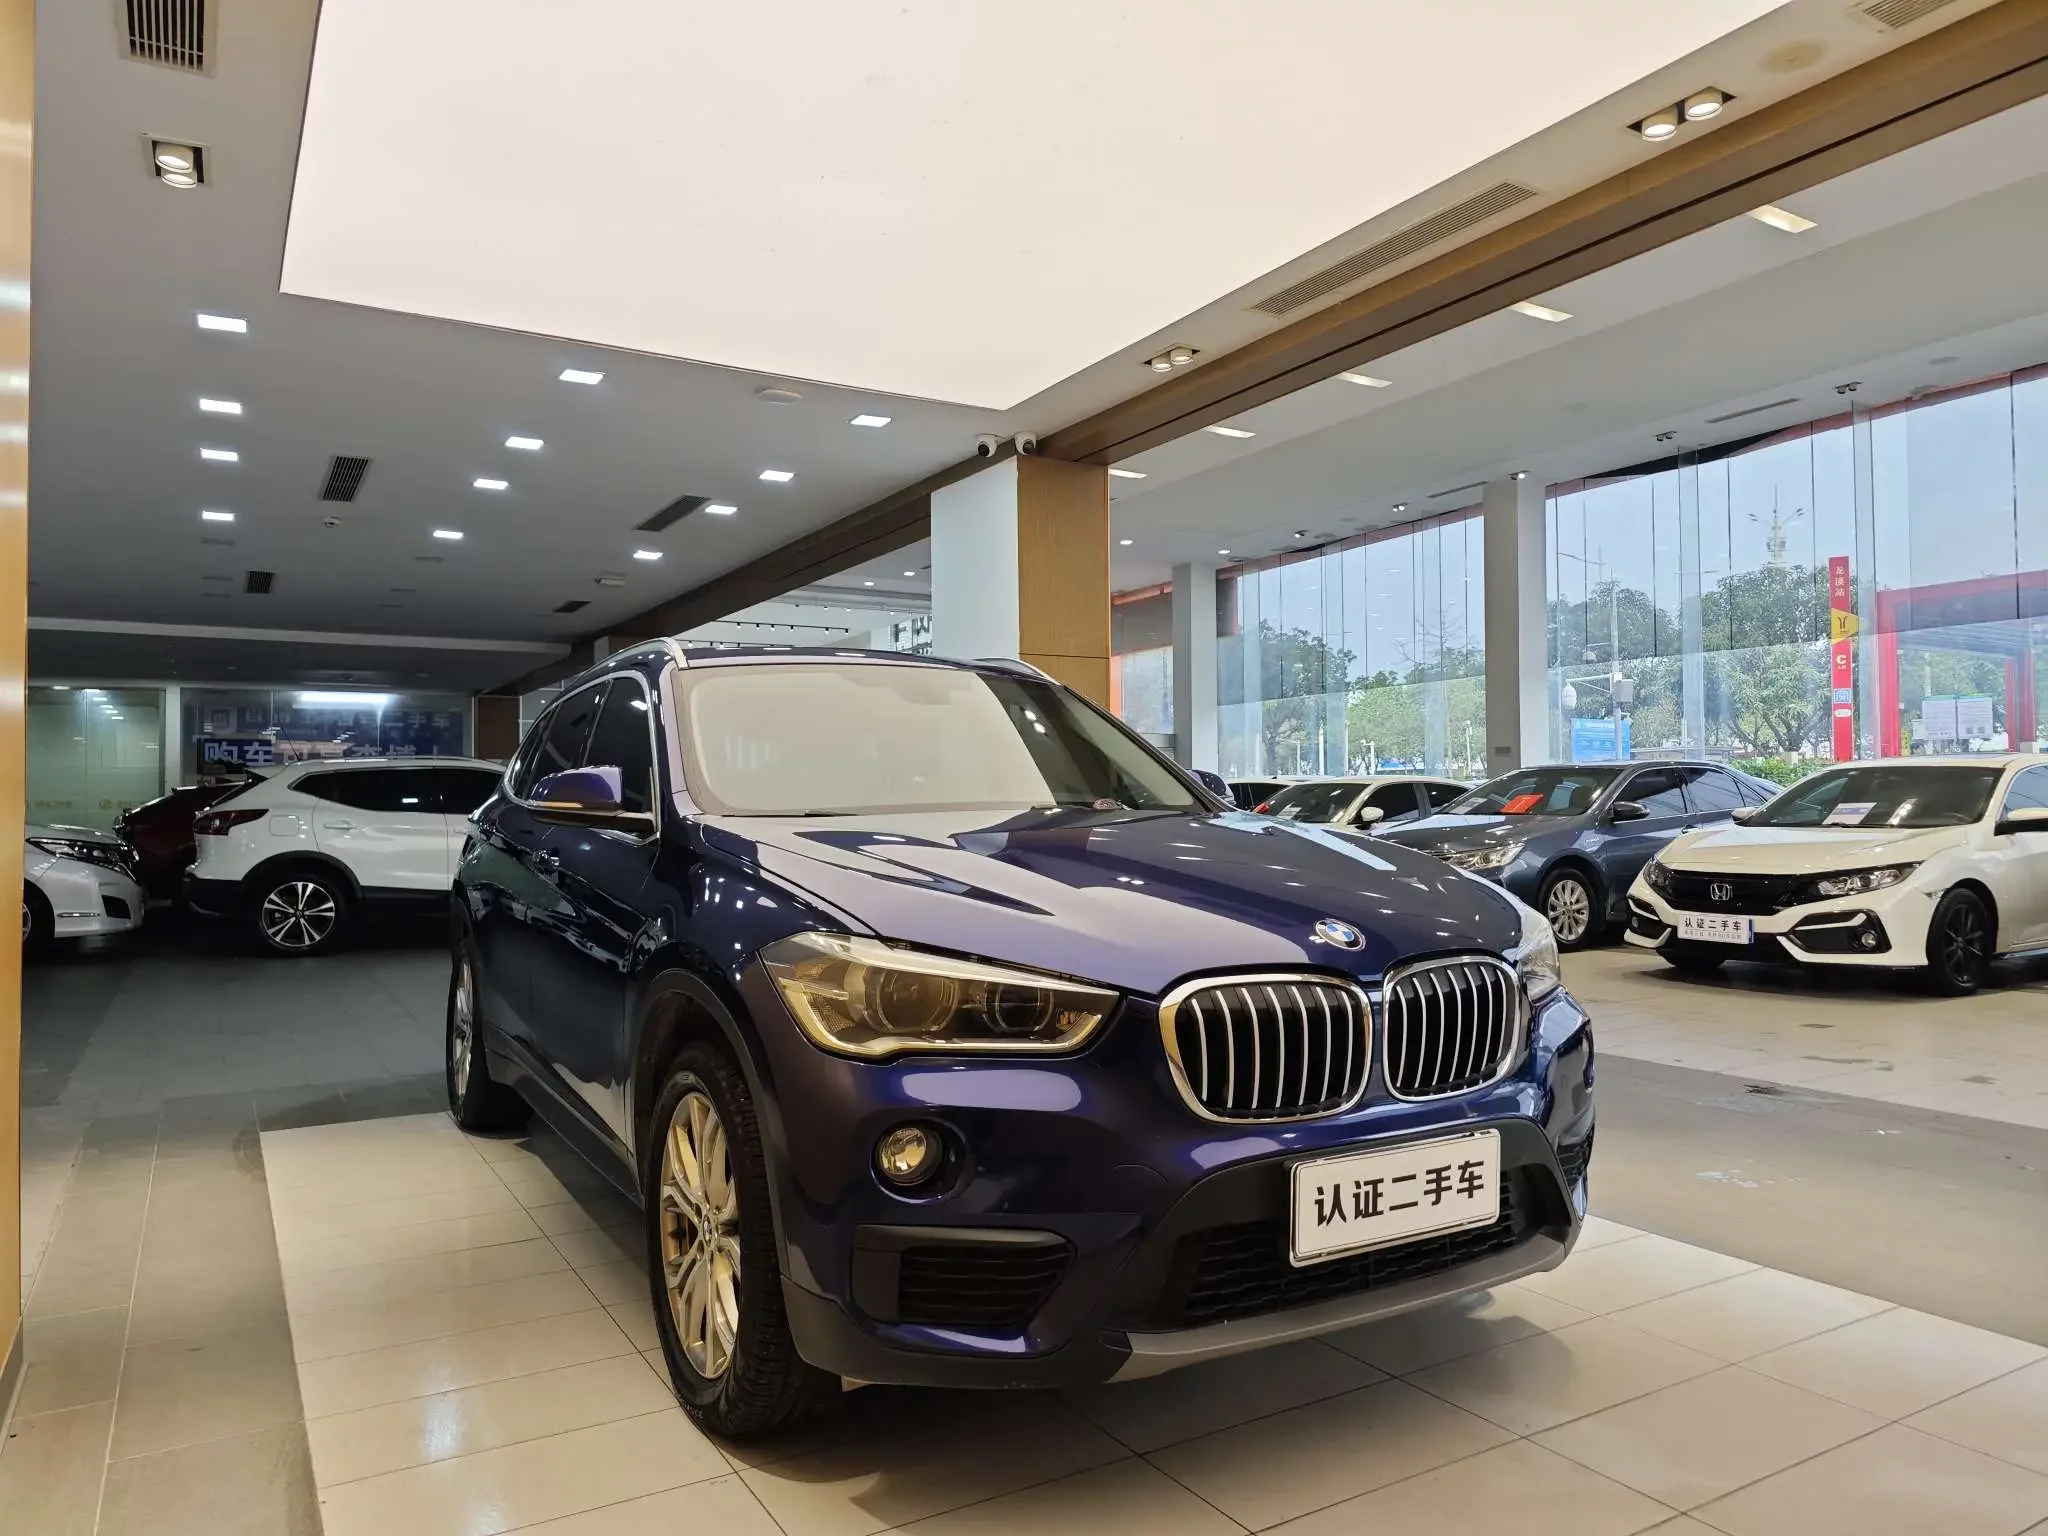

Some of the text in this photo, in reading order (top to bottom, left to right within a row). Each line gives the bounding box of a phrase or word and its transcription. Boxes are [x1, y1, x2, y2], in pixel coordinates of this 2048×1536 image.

[1684, 917, 1742, 932] 认证二手车
[1314, 1159, 1485, 1227] 认证二手车
